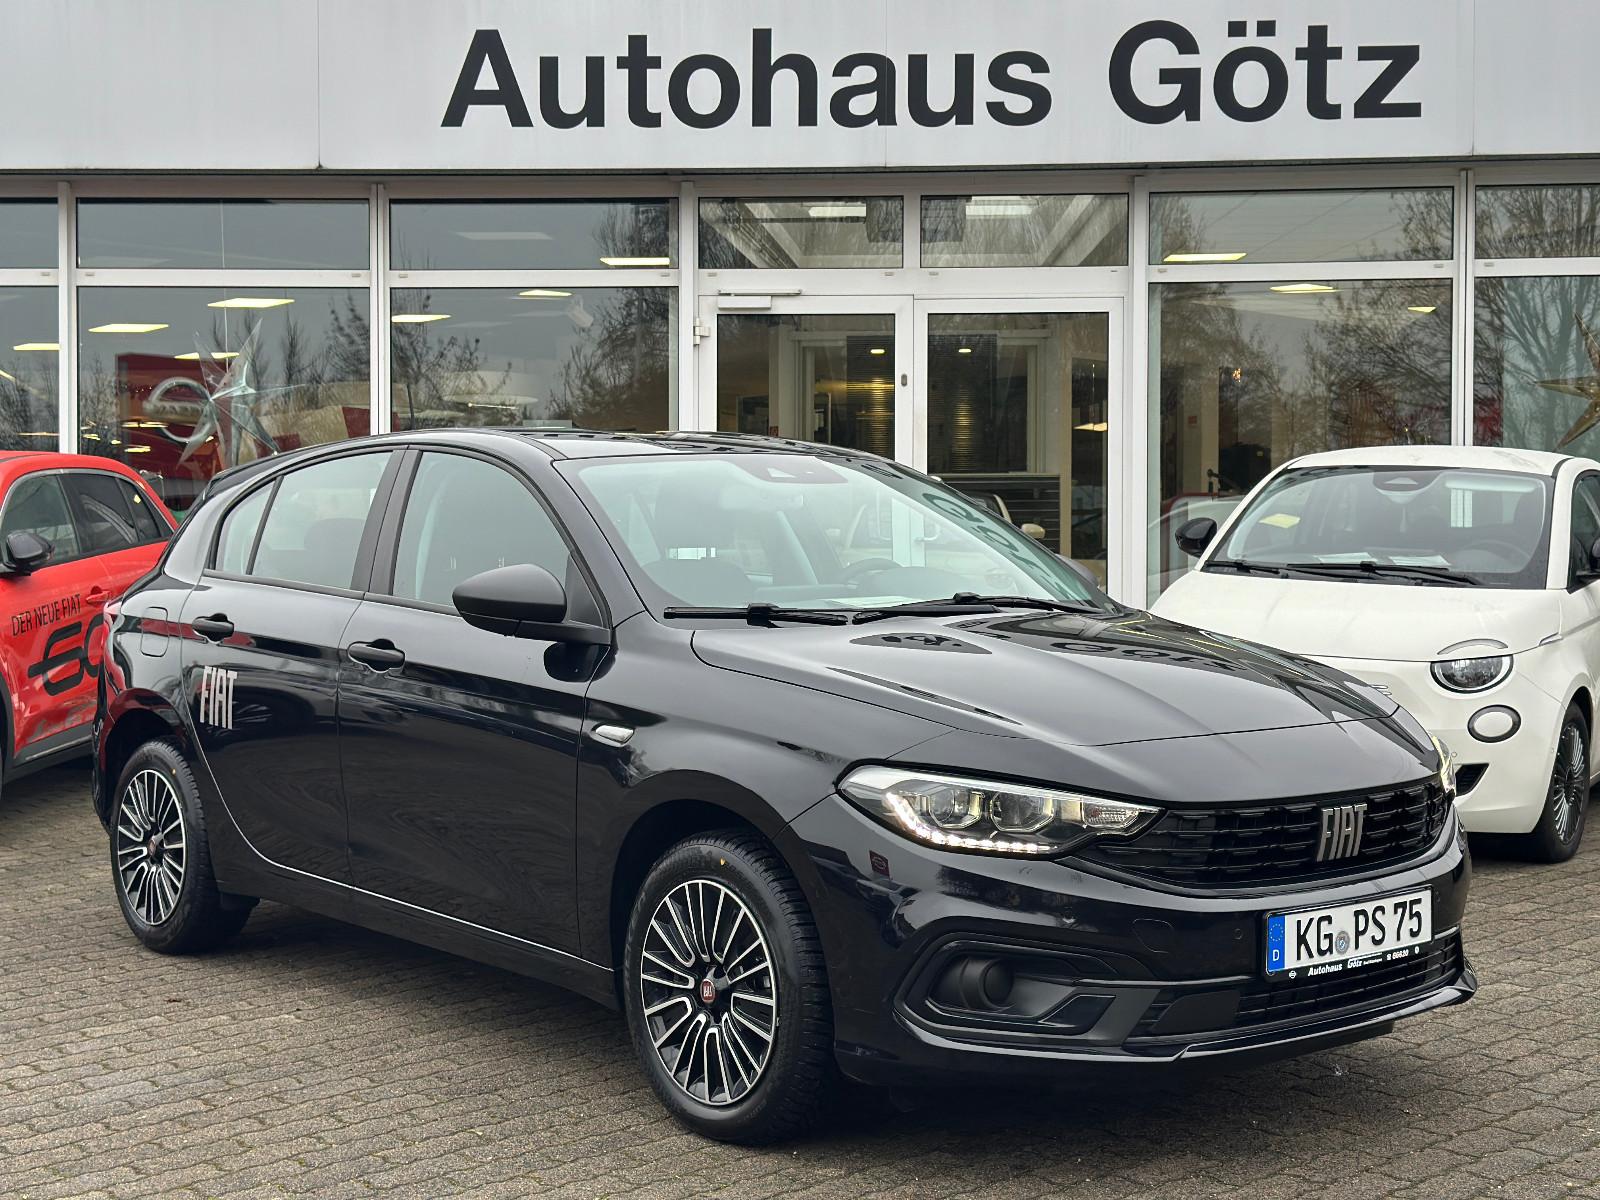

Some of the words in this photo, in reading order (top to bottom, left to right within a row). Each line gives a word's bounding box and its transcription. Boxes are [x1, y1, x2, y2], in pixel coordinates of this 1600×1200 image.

[441, 29, 1051, 128] Autohaus
[1109, 20, 1421, 124] Götz
[11, 610, 33, 636] DER
[34, 600, 60, 629] NEUE
[61, 593, 80, 619] FIAT
[200, 666, 238, 729] FIAT
[1317, 804, 1368, 862] FIAT
[1272, 949, 1280, 961] D
[1296, 914, 1334, 960] KG
[1353, 906, 1386, 950] PS
[1393, 898, 1423, 942] 75
[1308, 962, 1343, 977] Autohaus
